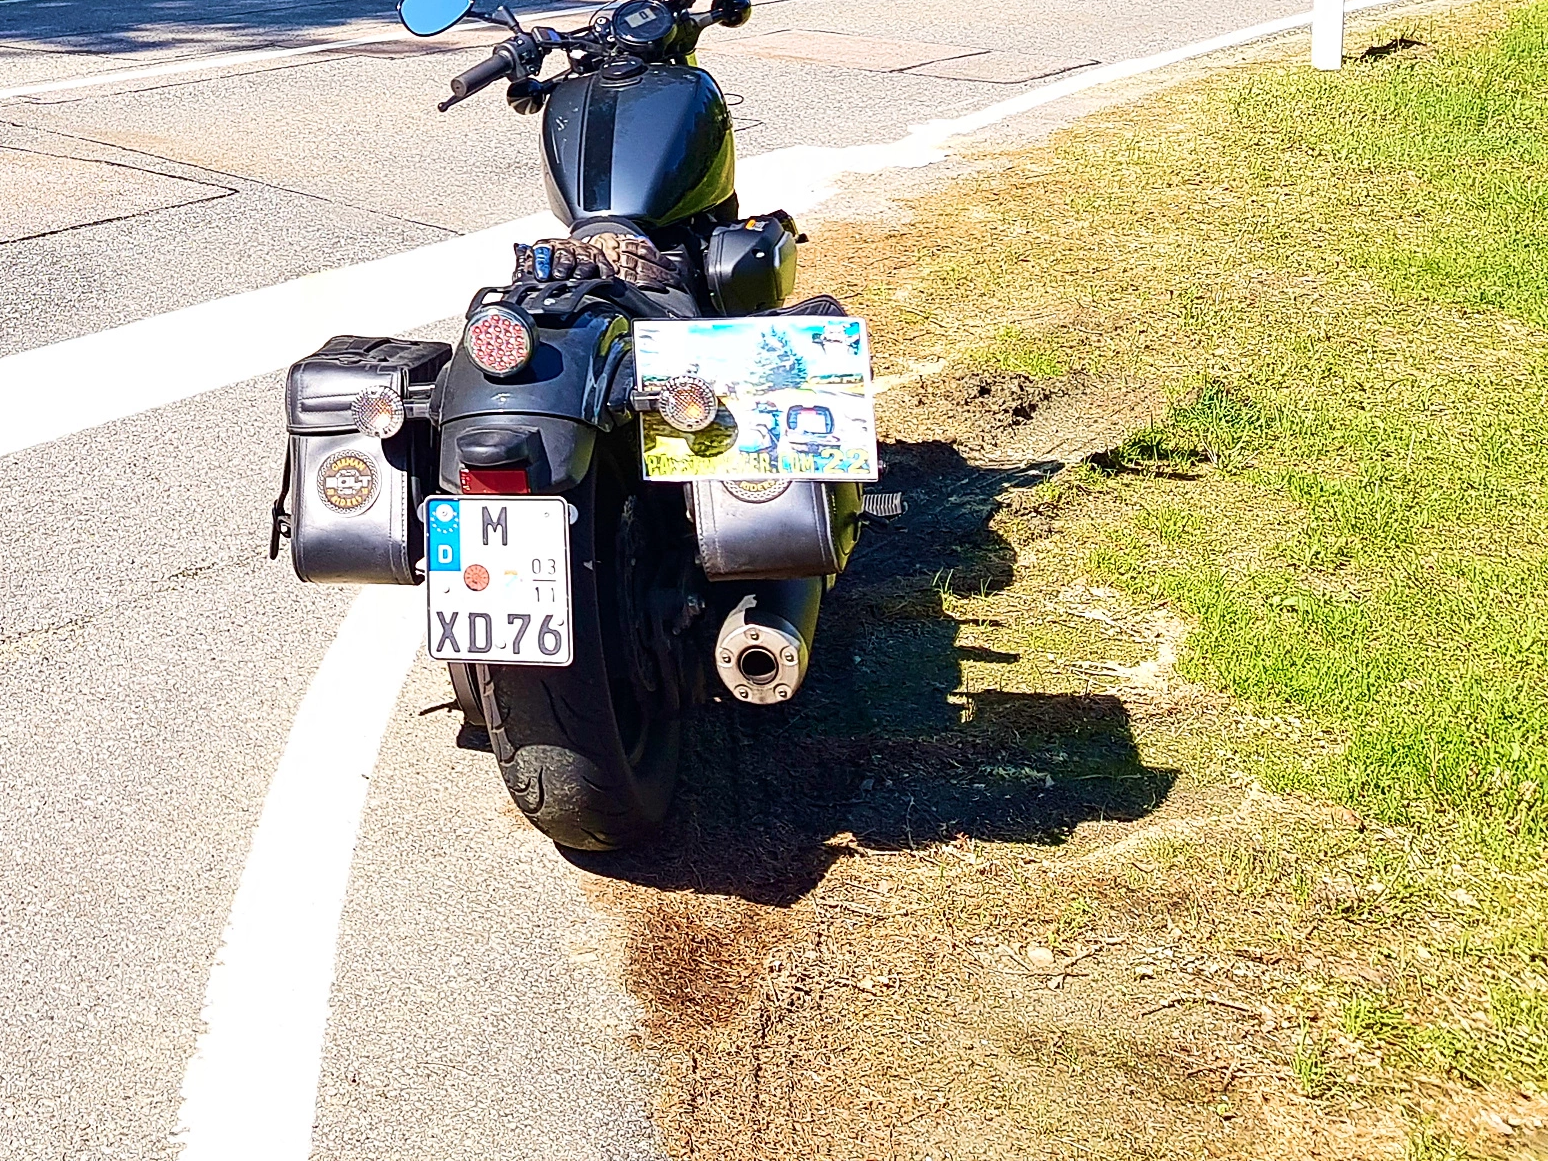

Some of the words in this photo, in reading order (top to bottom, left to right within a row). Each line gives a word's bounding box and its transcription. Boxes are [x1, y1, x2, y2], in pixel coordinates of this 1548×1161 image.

[820, 447, 871, 474] 22
[481, 506, 508, 547] M
[437, 544, 454, 564] D
[531, 558, 557, 576] 03
